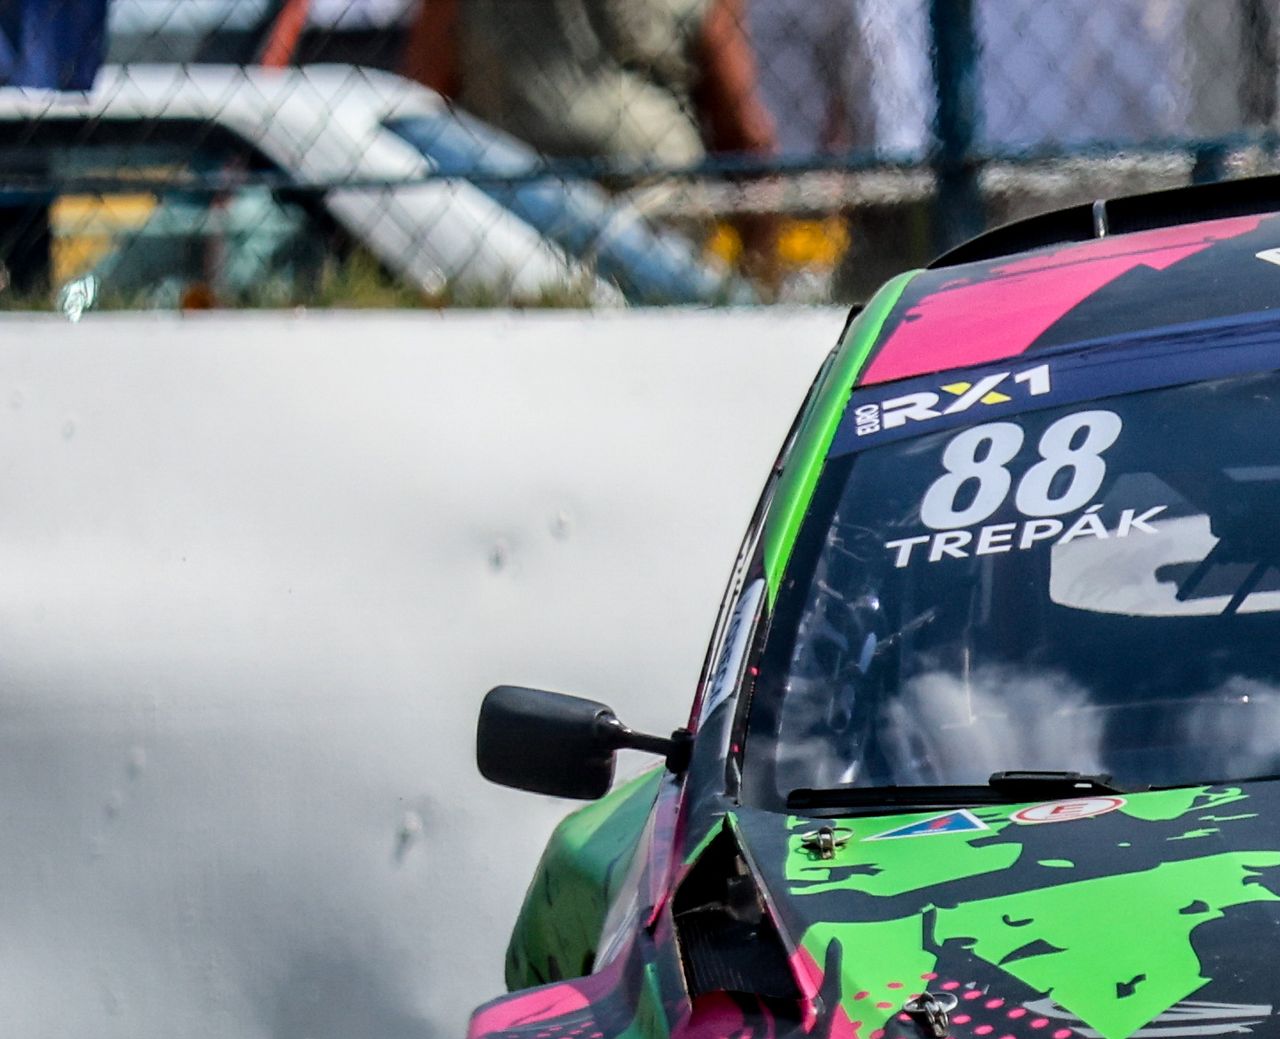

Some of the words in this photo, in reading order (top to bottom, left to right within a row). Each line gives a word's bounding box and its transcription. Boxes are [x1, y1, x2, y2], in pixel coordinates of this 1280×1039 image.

[853, 403, 881, 437] EURO
[881, 364, 1052, 431] RX1
[920, 410, 1123, 530] 88
[885, 504, 1169, 568] TREPÁK
